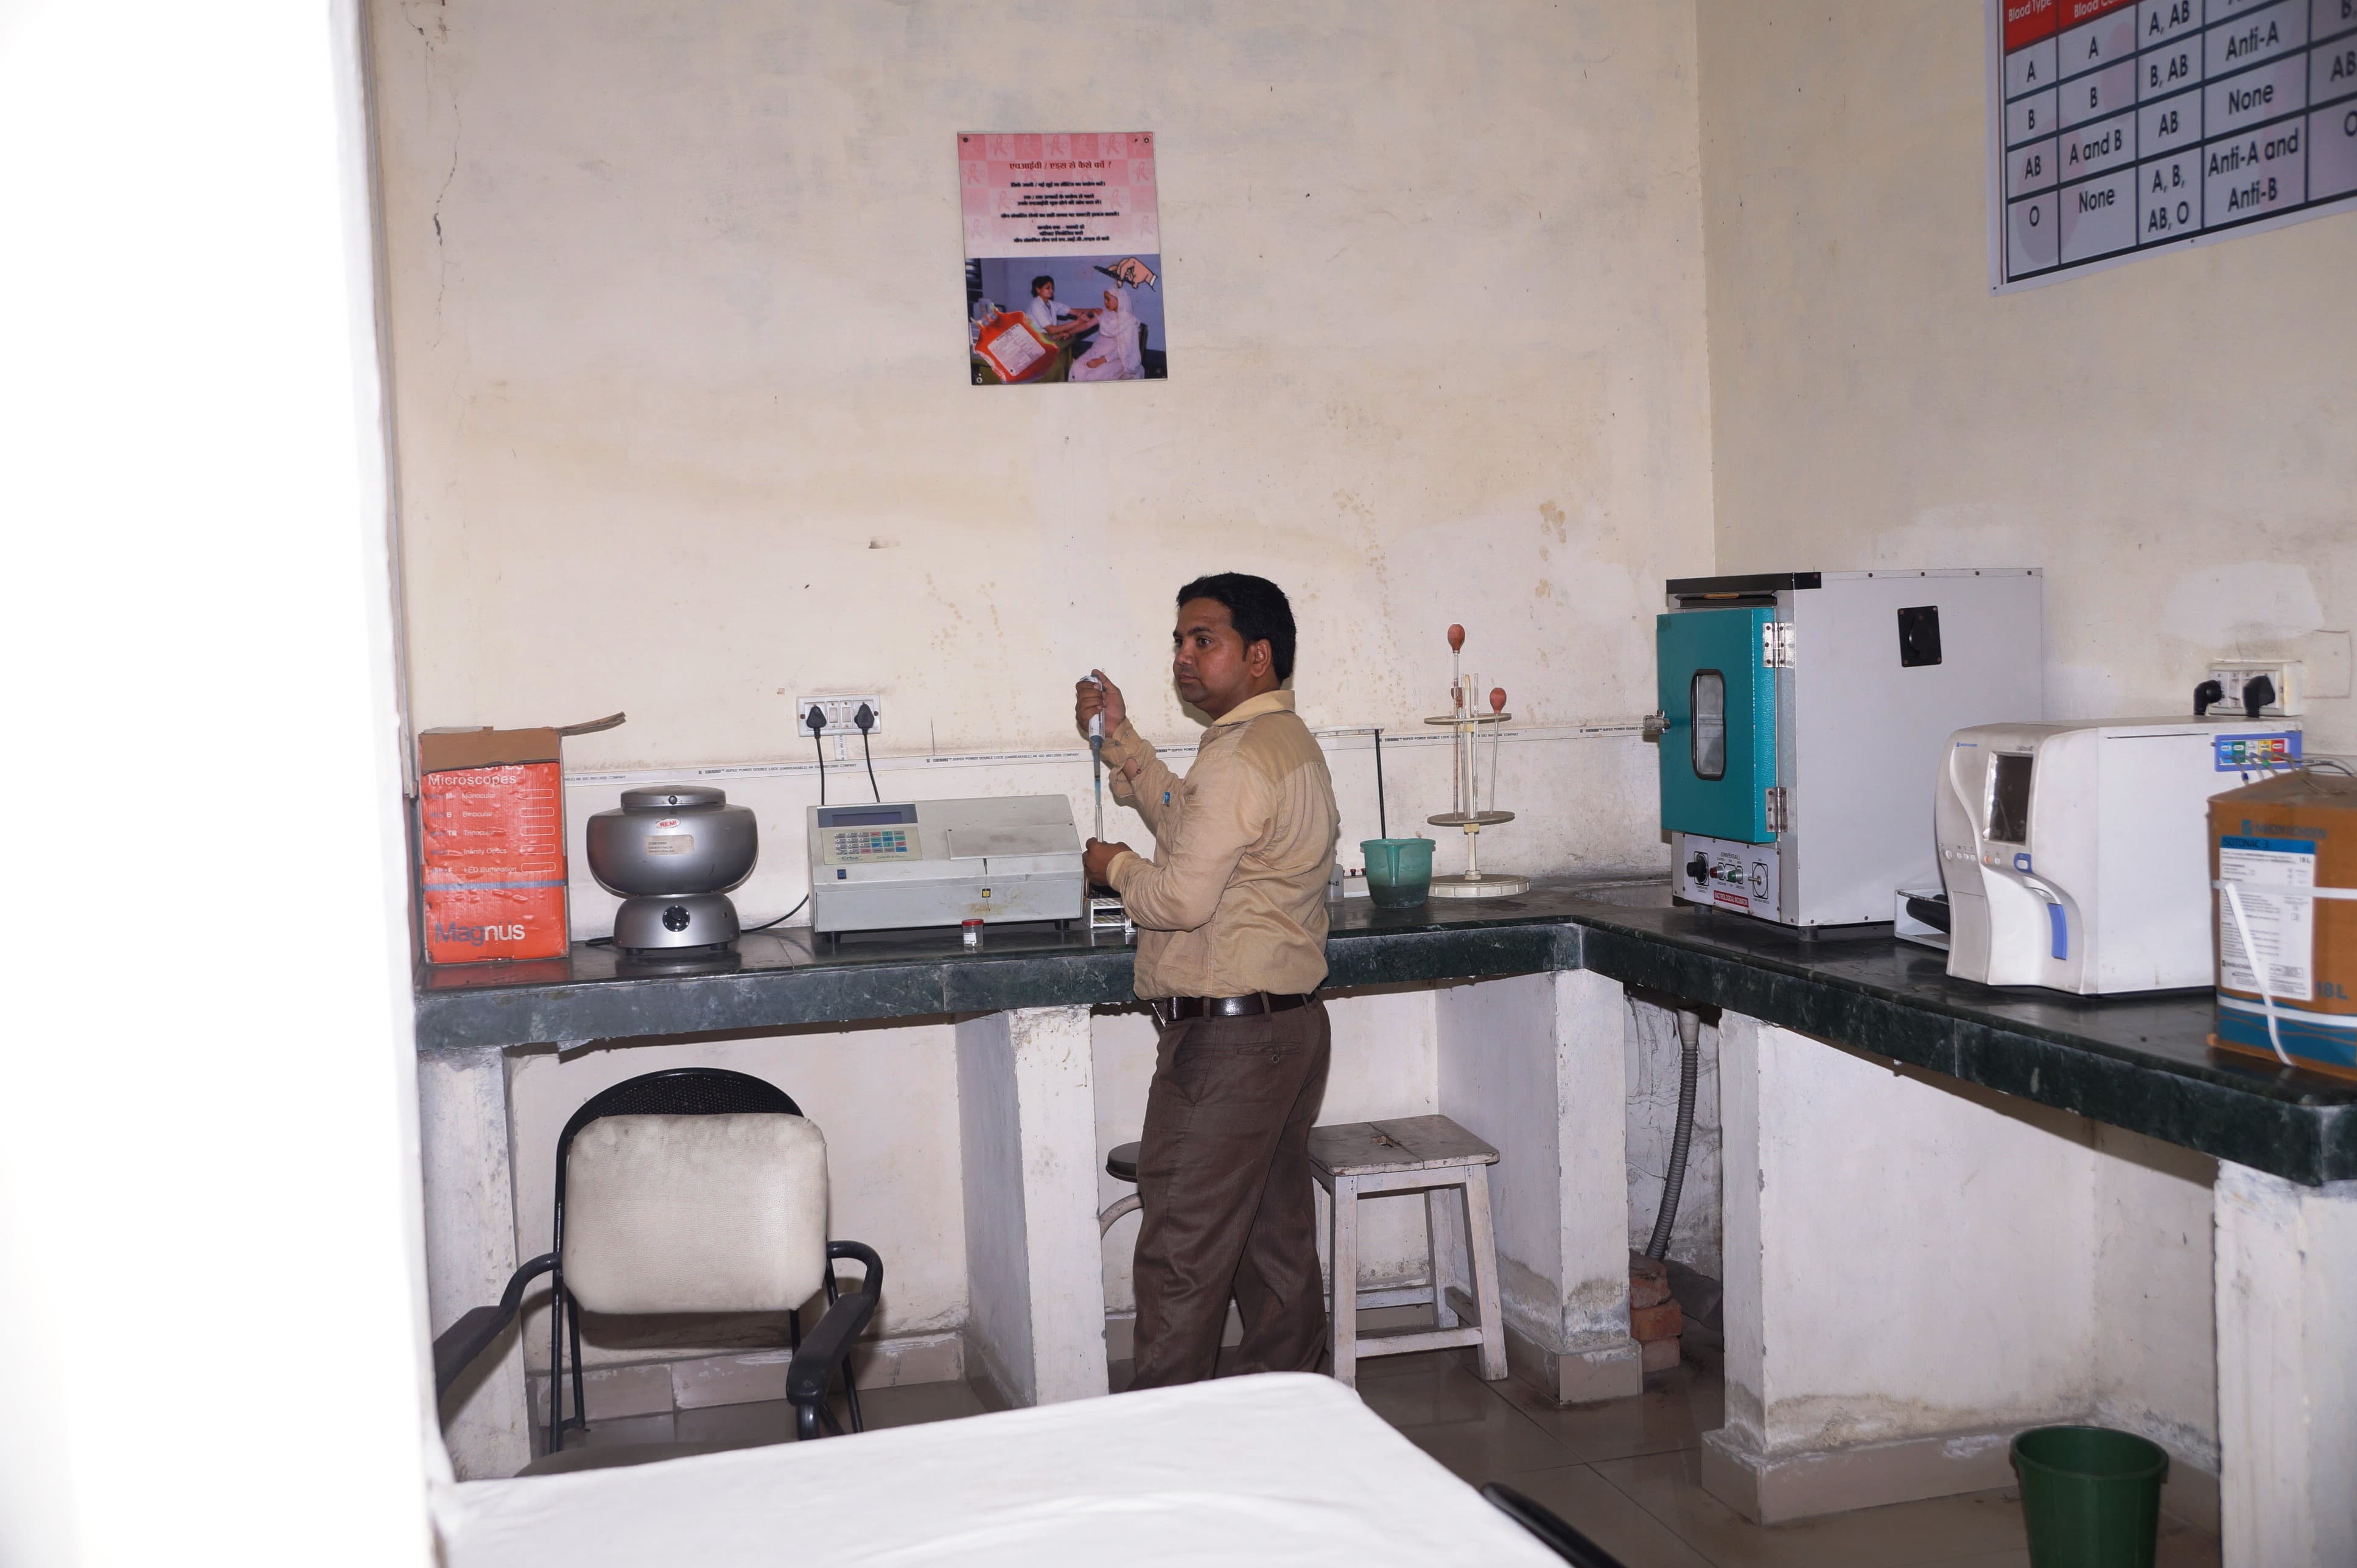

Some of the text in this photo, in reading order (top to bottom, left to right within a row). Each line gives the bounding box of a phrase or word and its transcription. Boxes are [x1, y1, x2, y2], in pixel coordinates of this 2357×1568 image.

[2008, 0, 2031, 22] Blood
[2074, 0, 2098, 18] Blood
[2148, 1, 2190, 37] A, AB
[2088, 36, 2099, 59] A
[2226, 20, 2279, 61] Anti-A
[2026, 60, 2036, 83] A
[2150, 54, 2188, 88] B, AB
[2090, 86, 2098, 109] B
[2229, 83, 2274, 115] None
[2028, 109, 2036, 130] B
[2159, 110, 2179, 138] AB
[2069, 128, 2123, 166] A and B
[2208, 127, 2299, 178] Anti-A and
[2025, 155, 2041, 180] AB
[2152, 164, 2185, 194] A, B,
[2078, 188, 2115, 214] None
[2227, 177, 2278, 213] Anti-B
[2029, 206, 2040, 227] O
[2148, 201, 2190, 234] AB, O
[428, 774, 517, 786] Microscopes
[486, 847, 507, 855] Optics
[2316, 981, 2333, 998] 18
[2336, 982, 2348, 1000] L
